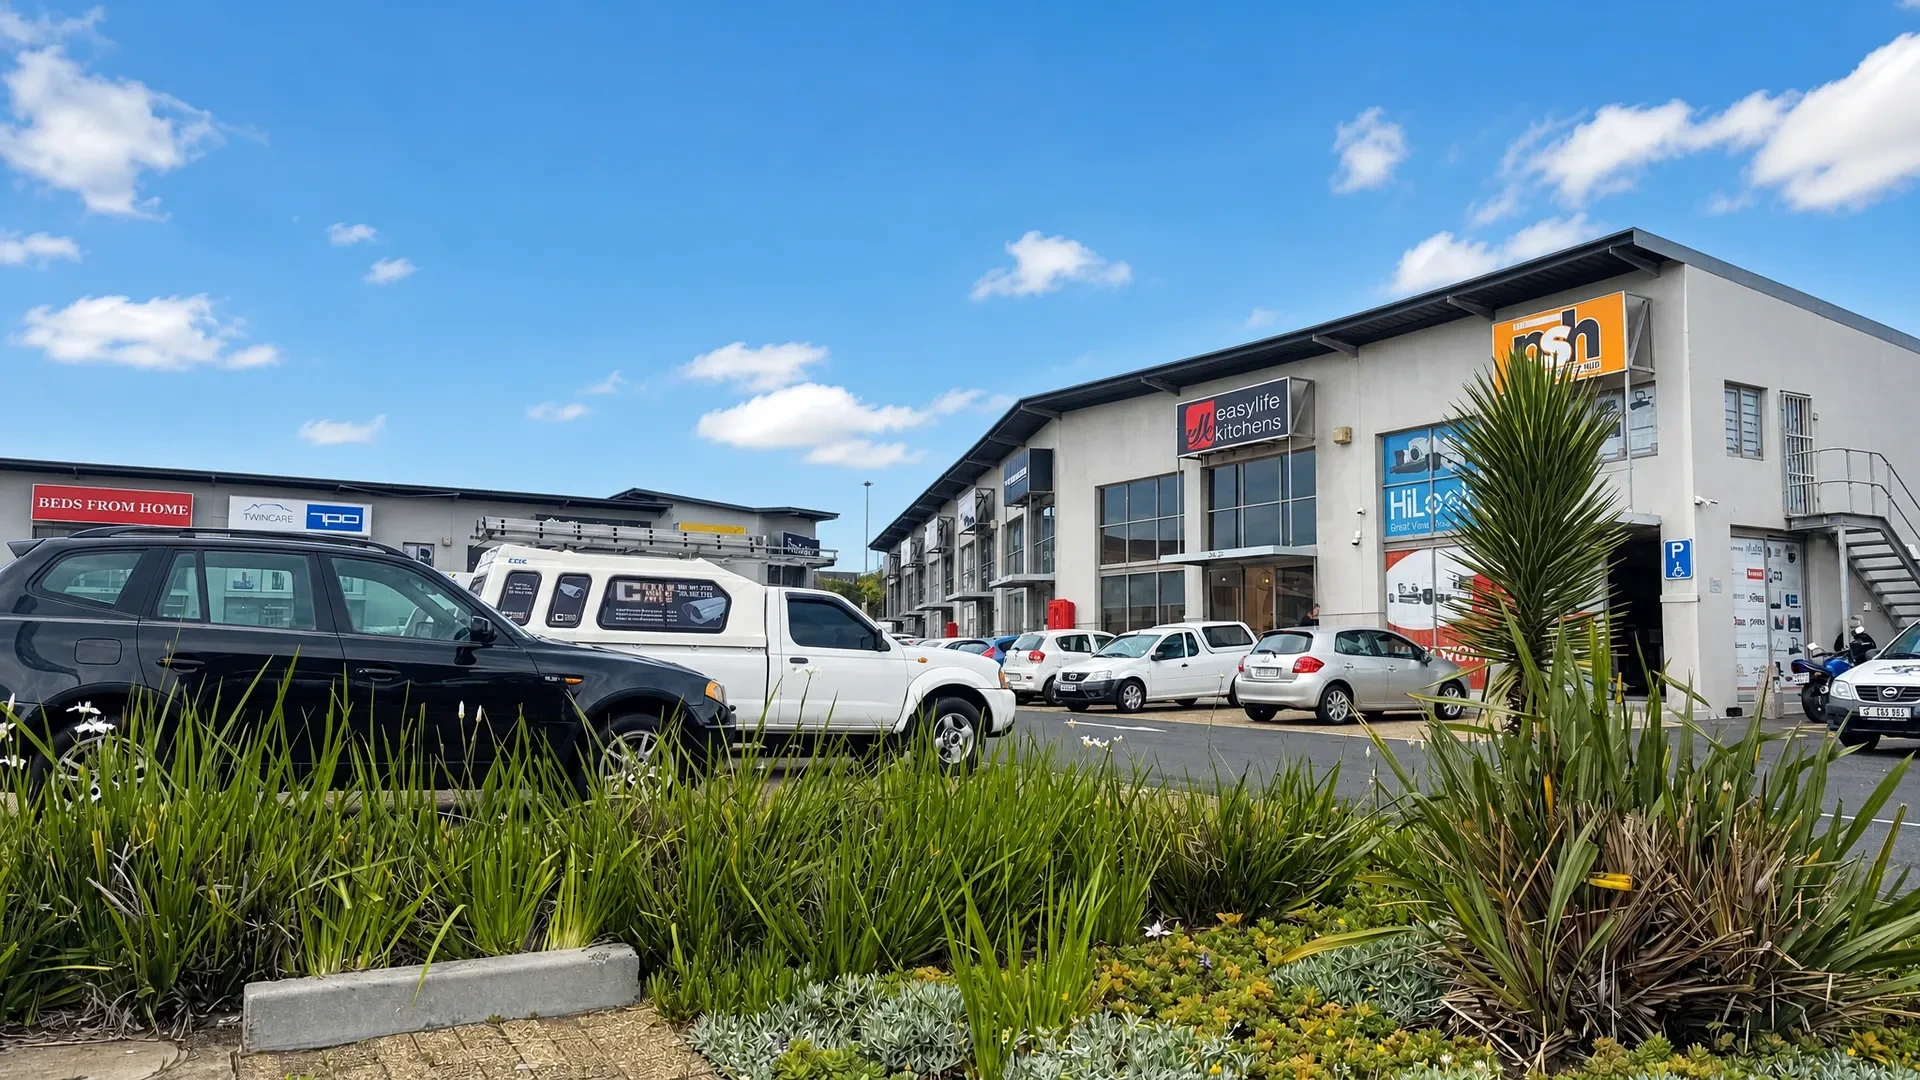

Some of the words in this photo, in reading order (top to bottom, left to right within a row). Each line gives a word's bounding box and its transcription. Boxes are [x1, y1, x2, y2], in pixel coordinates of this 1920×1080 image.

[1216, 393, 1280, 421] easylife
[1215, 417, 1281, 441] kitchens
[38, 497, 83, 510] BEDS
[87, 499, 135, 513] FROM
[139, 502, 189, 516] HOME
[243, 512, 293, 524] TWINCARE
[1390, 521, 1411, 533] Great
[1671, 542, 1685, 559] P
